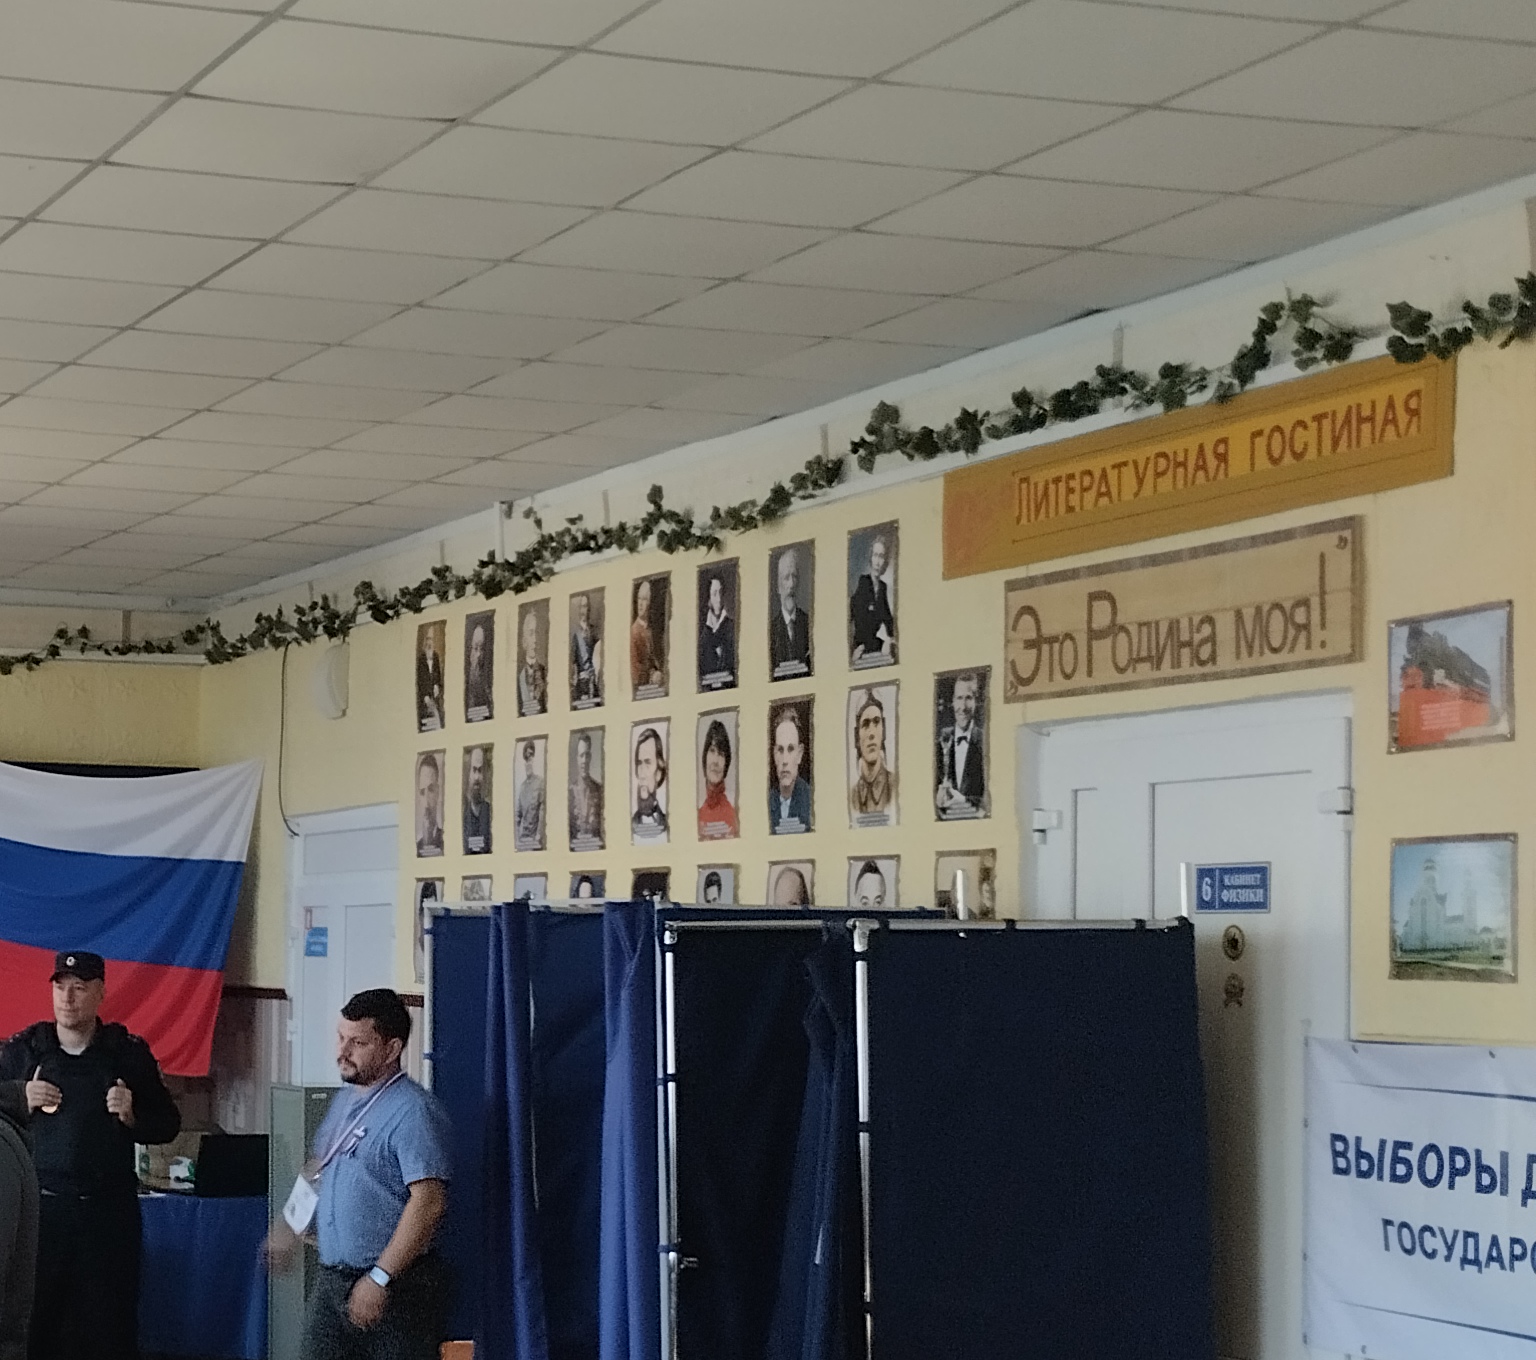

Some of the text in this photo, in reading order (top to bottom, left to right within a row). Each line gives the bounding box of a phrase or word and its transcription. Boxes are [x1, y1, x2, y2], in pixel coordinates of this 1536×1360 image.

[1015, 388, 1423, 525] ЛИТЕРАТУРНАЯ ГОСТИНАЯ
[1086, 589, 1218, 678] Родина
[1202, 877, 1212, 902] 6
[1221, 888, 1264, 903] ФИЗИКИ
[1330, 1133, 1510, 1198] ВЫБОРЫ
